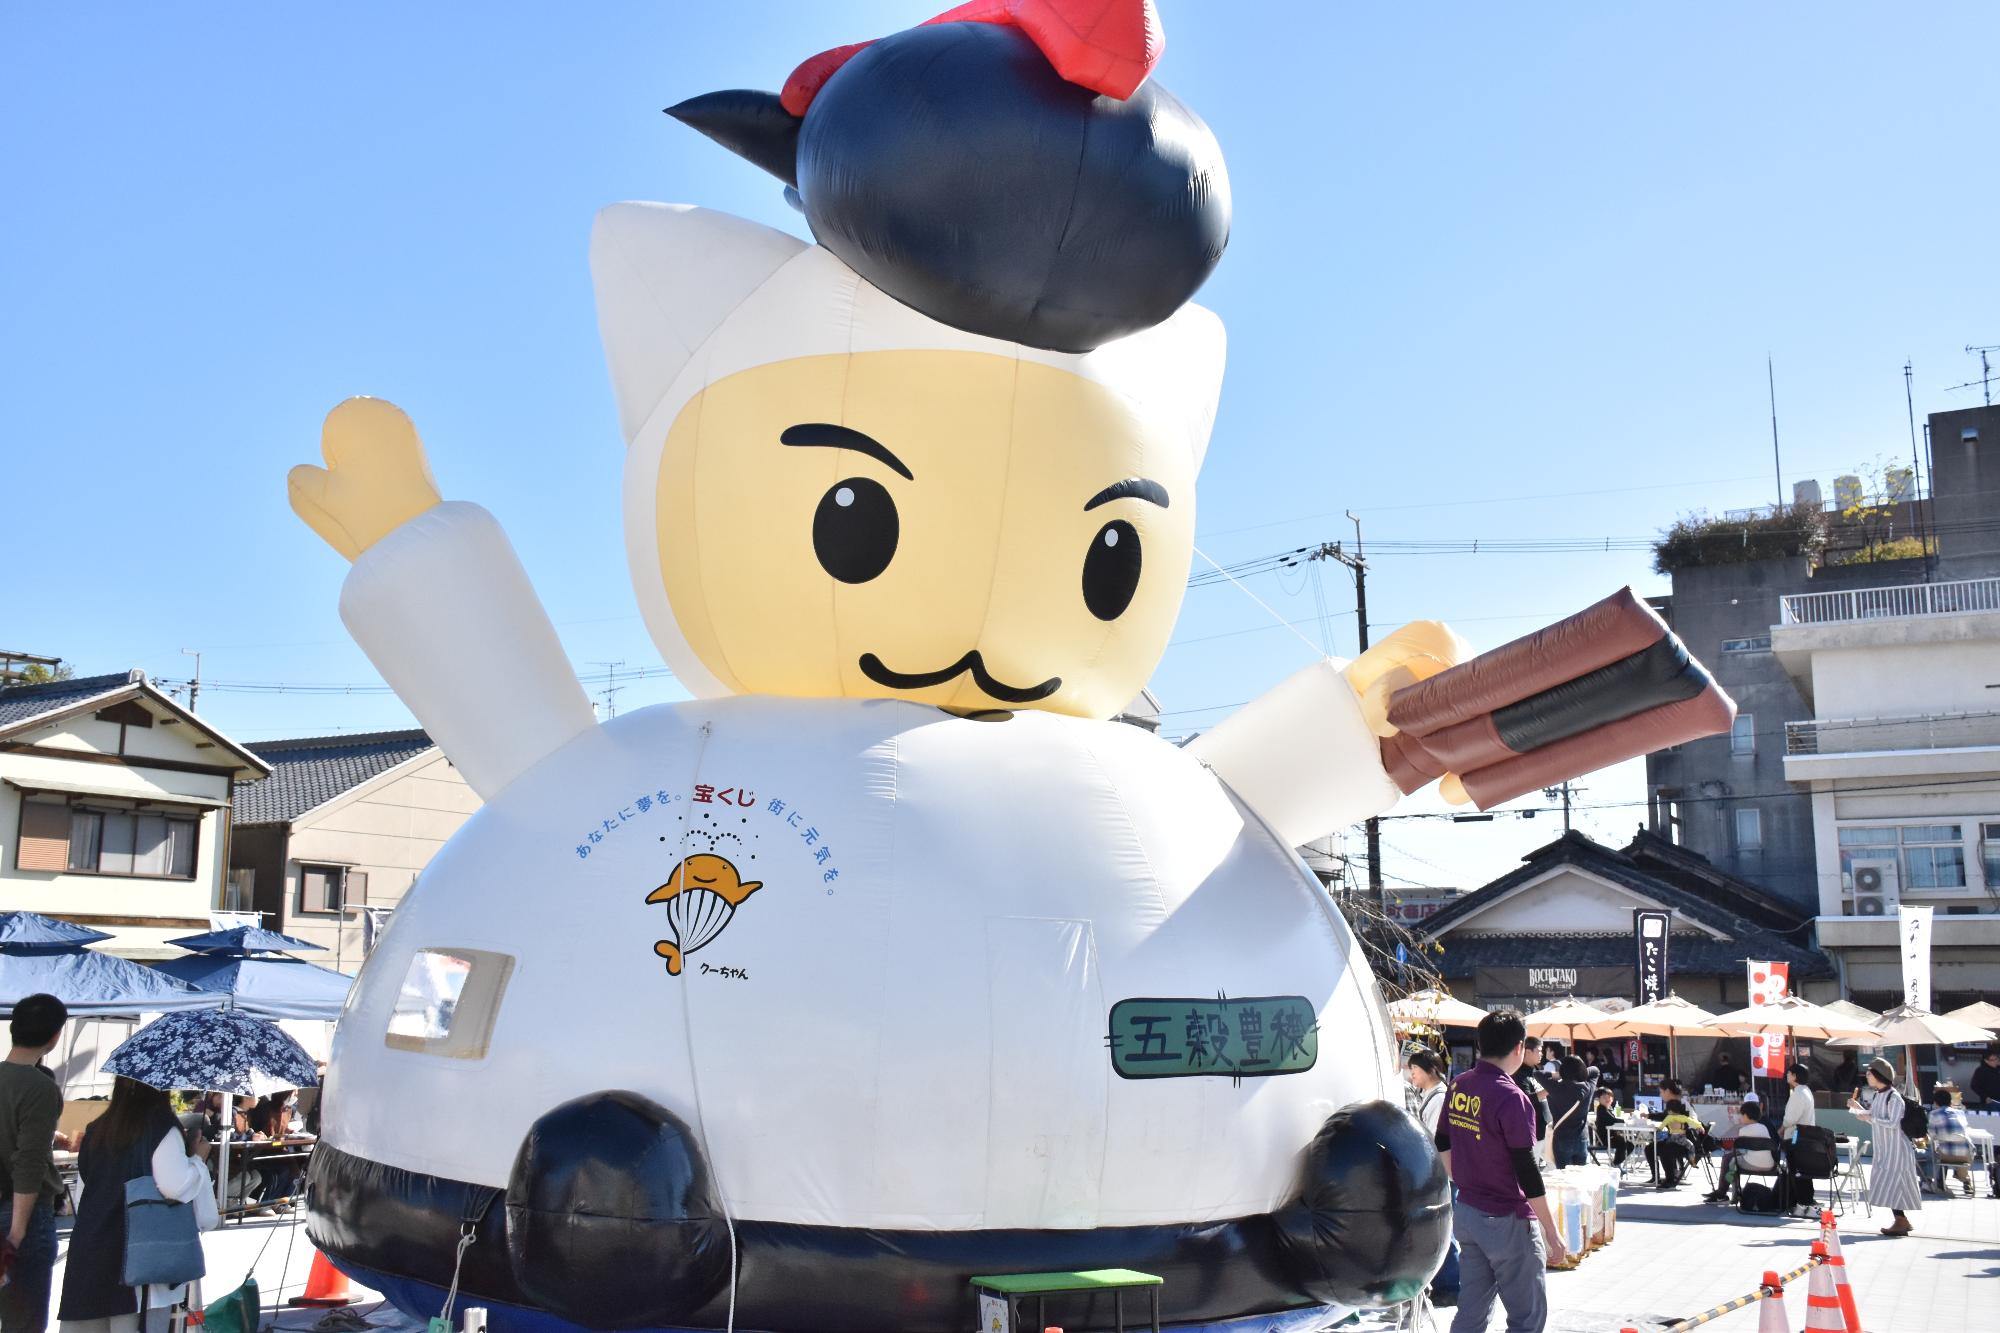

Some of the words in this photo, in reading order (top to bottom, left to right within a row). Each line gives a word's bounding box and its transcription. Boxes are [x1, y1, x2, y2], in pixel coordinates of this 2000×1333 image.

[576, 790, 682, 859] あなたに夢を。
[693, 784, 755, 807] 宝くじ
[767, 798, 839, 896] 街に元気を。
[700, 962, 749, 980] クーちゃん
[1449, 1091, 1471, 1112] JCI
